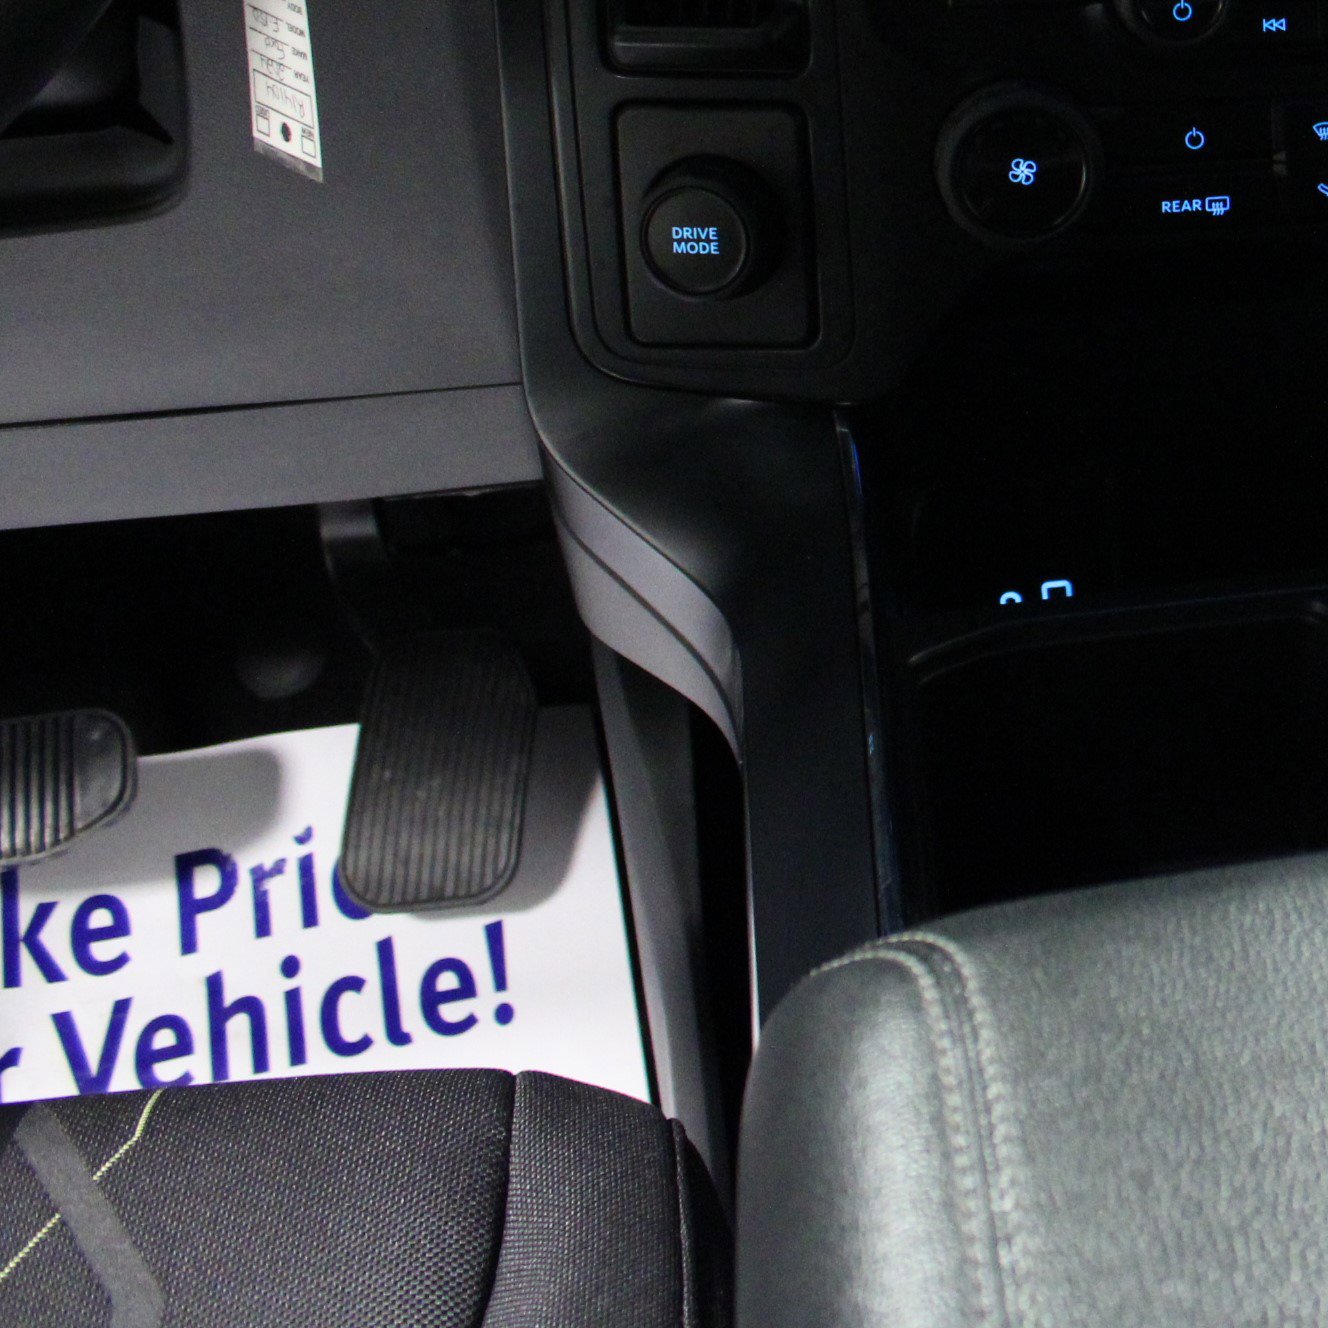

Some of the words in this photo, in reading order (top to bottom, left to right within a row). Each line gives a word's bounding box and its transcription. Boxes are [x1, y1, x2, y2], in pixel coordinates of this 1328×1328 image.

[1162, 200, 1202, 214] REAR
[671, 227, 717, 239] DRIVE
[673, 242, 720, 254] MODE
[51, 920, 514, 1095] Vehicle!
